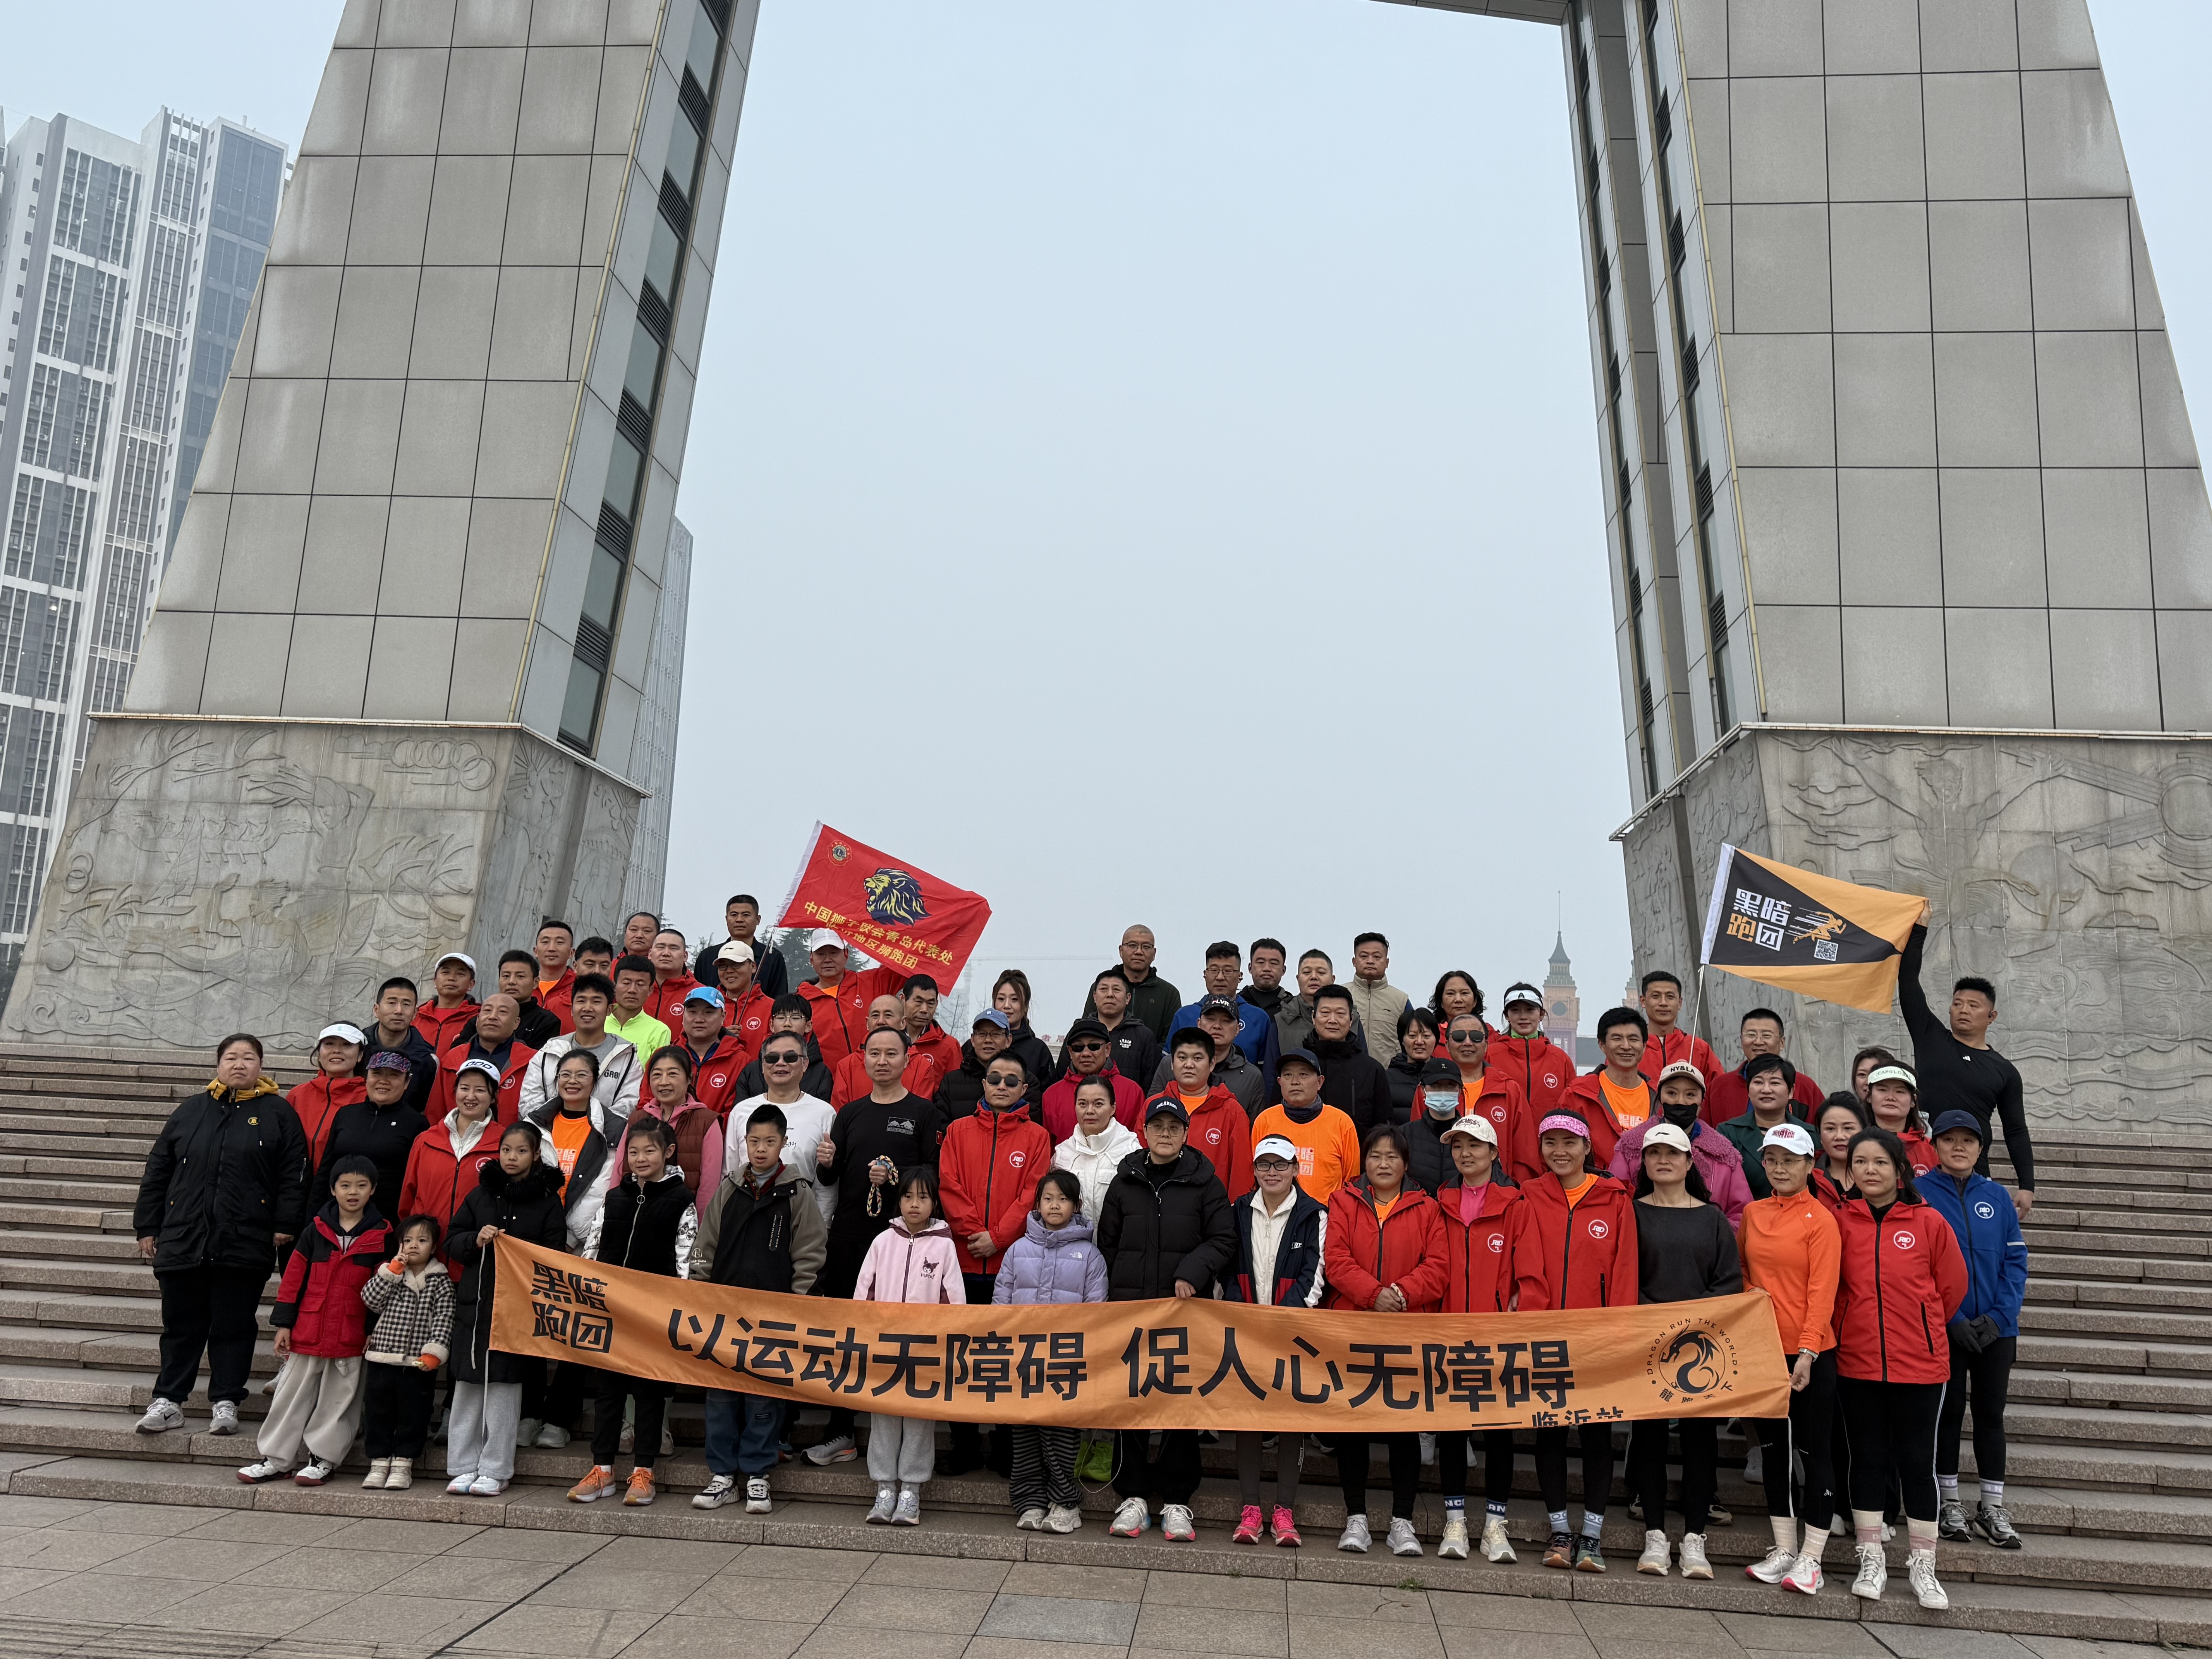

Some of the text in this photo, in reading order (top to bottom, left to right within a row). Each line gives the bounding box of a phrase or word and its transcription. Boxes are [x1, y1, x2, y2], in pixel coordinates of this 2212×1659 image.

[1726, 913, 1784, 951] 跑团
[1733, 888, 1792, 926] 黑暗
[1671, 1066, 1695, 1074] NY&LA
[531, 1260, 610, 1312] 黑暗
[532, 1301, 613, 1353] 跑团
[1647, 1318, 1738, 1375] DRAGON RUN THE WORLD
[668, 1309, 1575, 1412] 以运动无障碍 促人心无障碍
